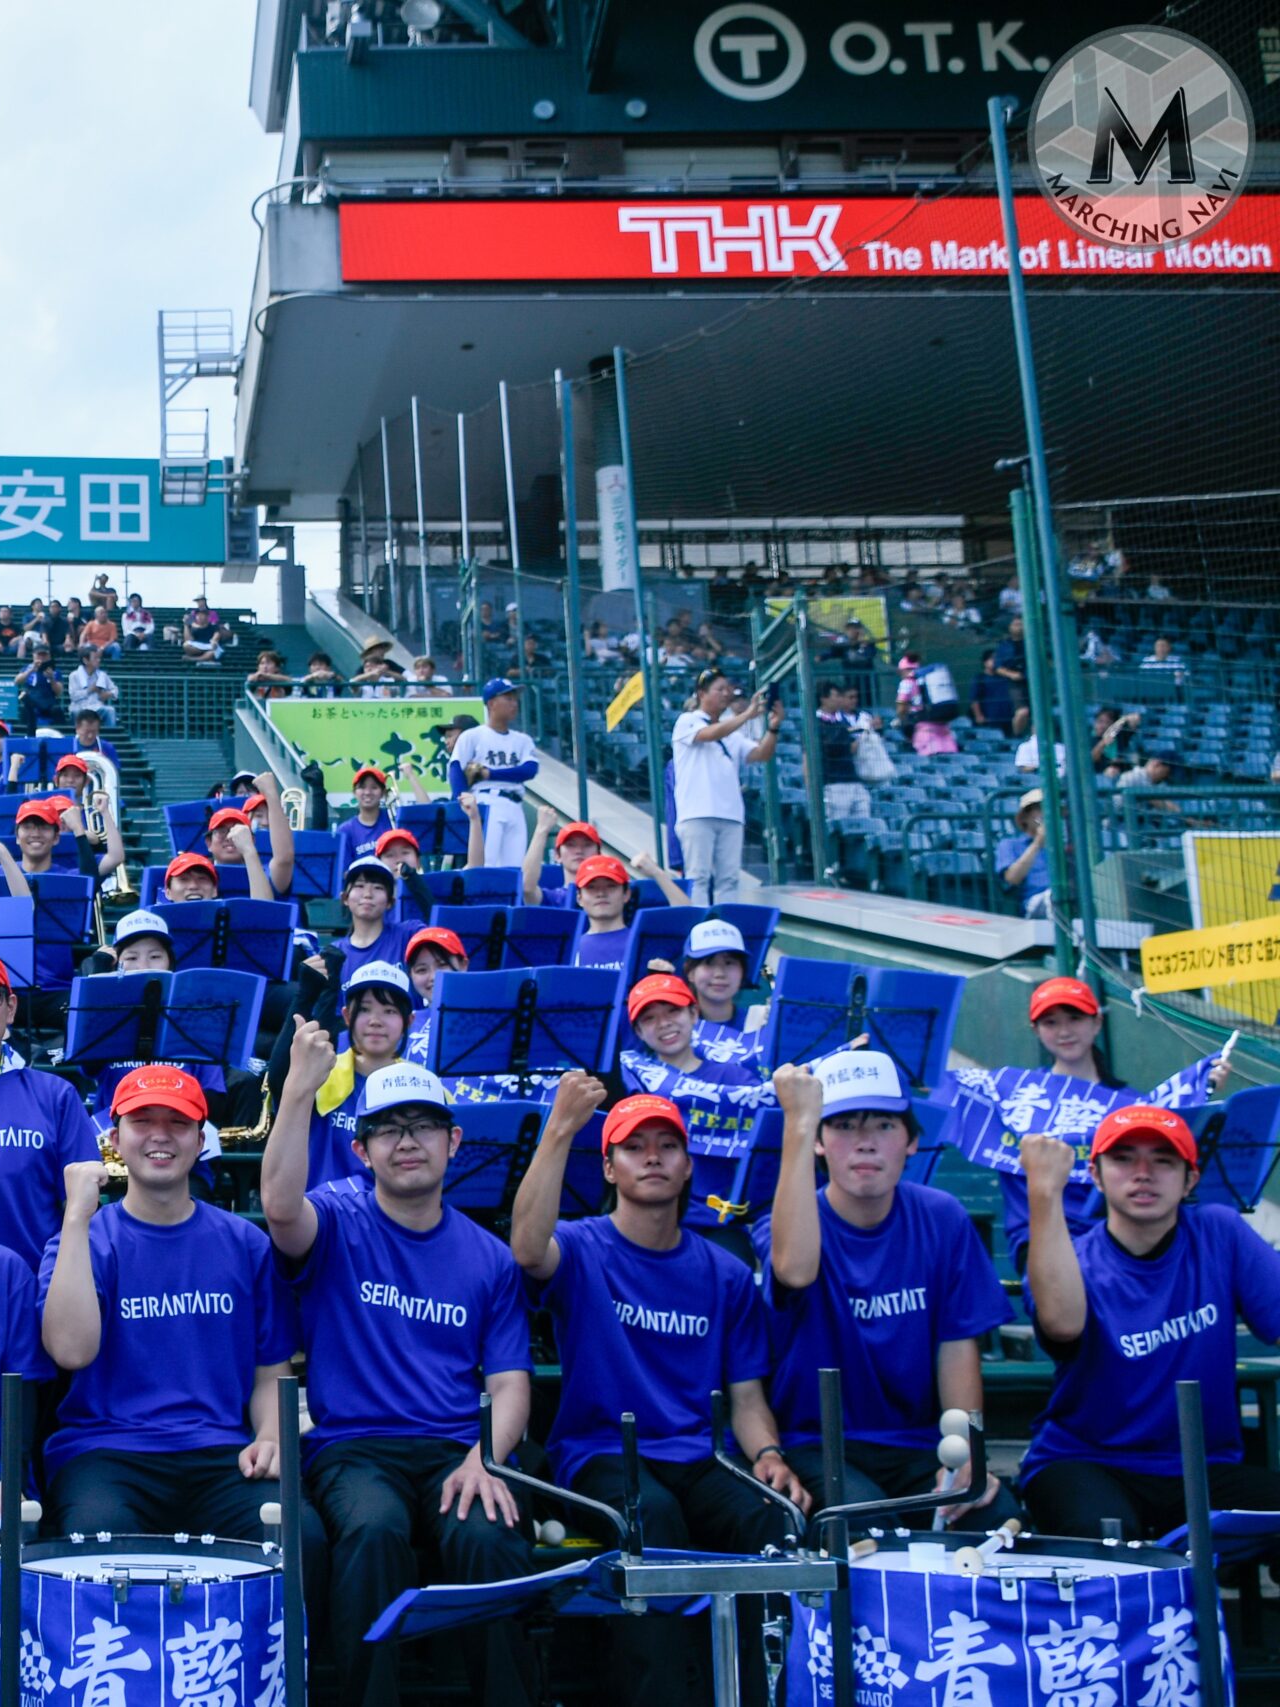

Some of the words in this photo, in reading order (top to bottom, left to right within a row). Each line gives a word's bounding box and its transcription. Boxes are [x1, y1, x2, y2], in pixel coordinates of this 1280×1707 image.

[830, 20, 1051, 76] O.T.K.
[618, 204, 849, 273] THK
[861, 240, 923, 270] The
[931, 239, 1010, 270] Mark
[1018, 238, 1050, 270] of
[1058, 238, 1155, 270] Linear
[1164, 238, 1273, 270] Motion
[120, 1289, 234, 1319] SEIRANTAITO
[360, 1280, 468, 1328] SEIRNTAITO
